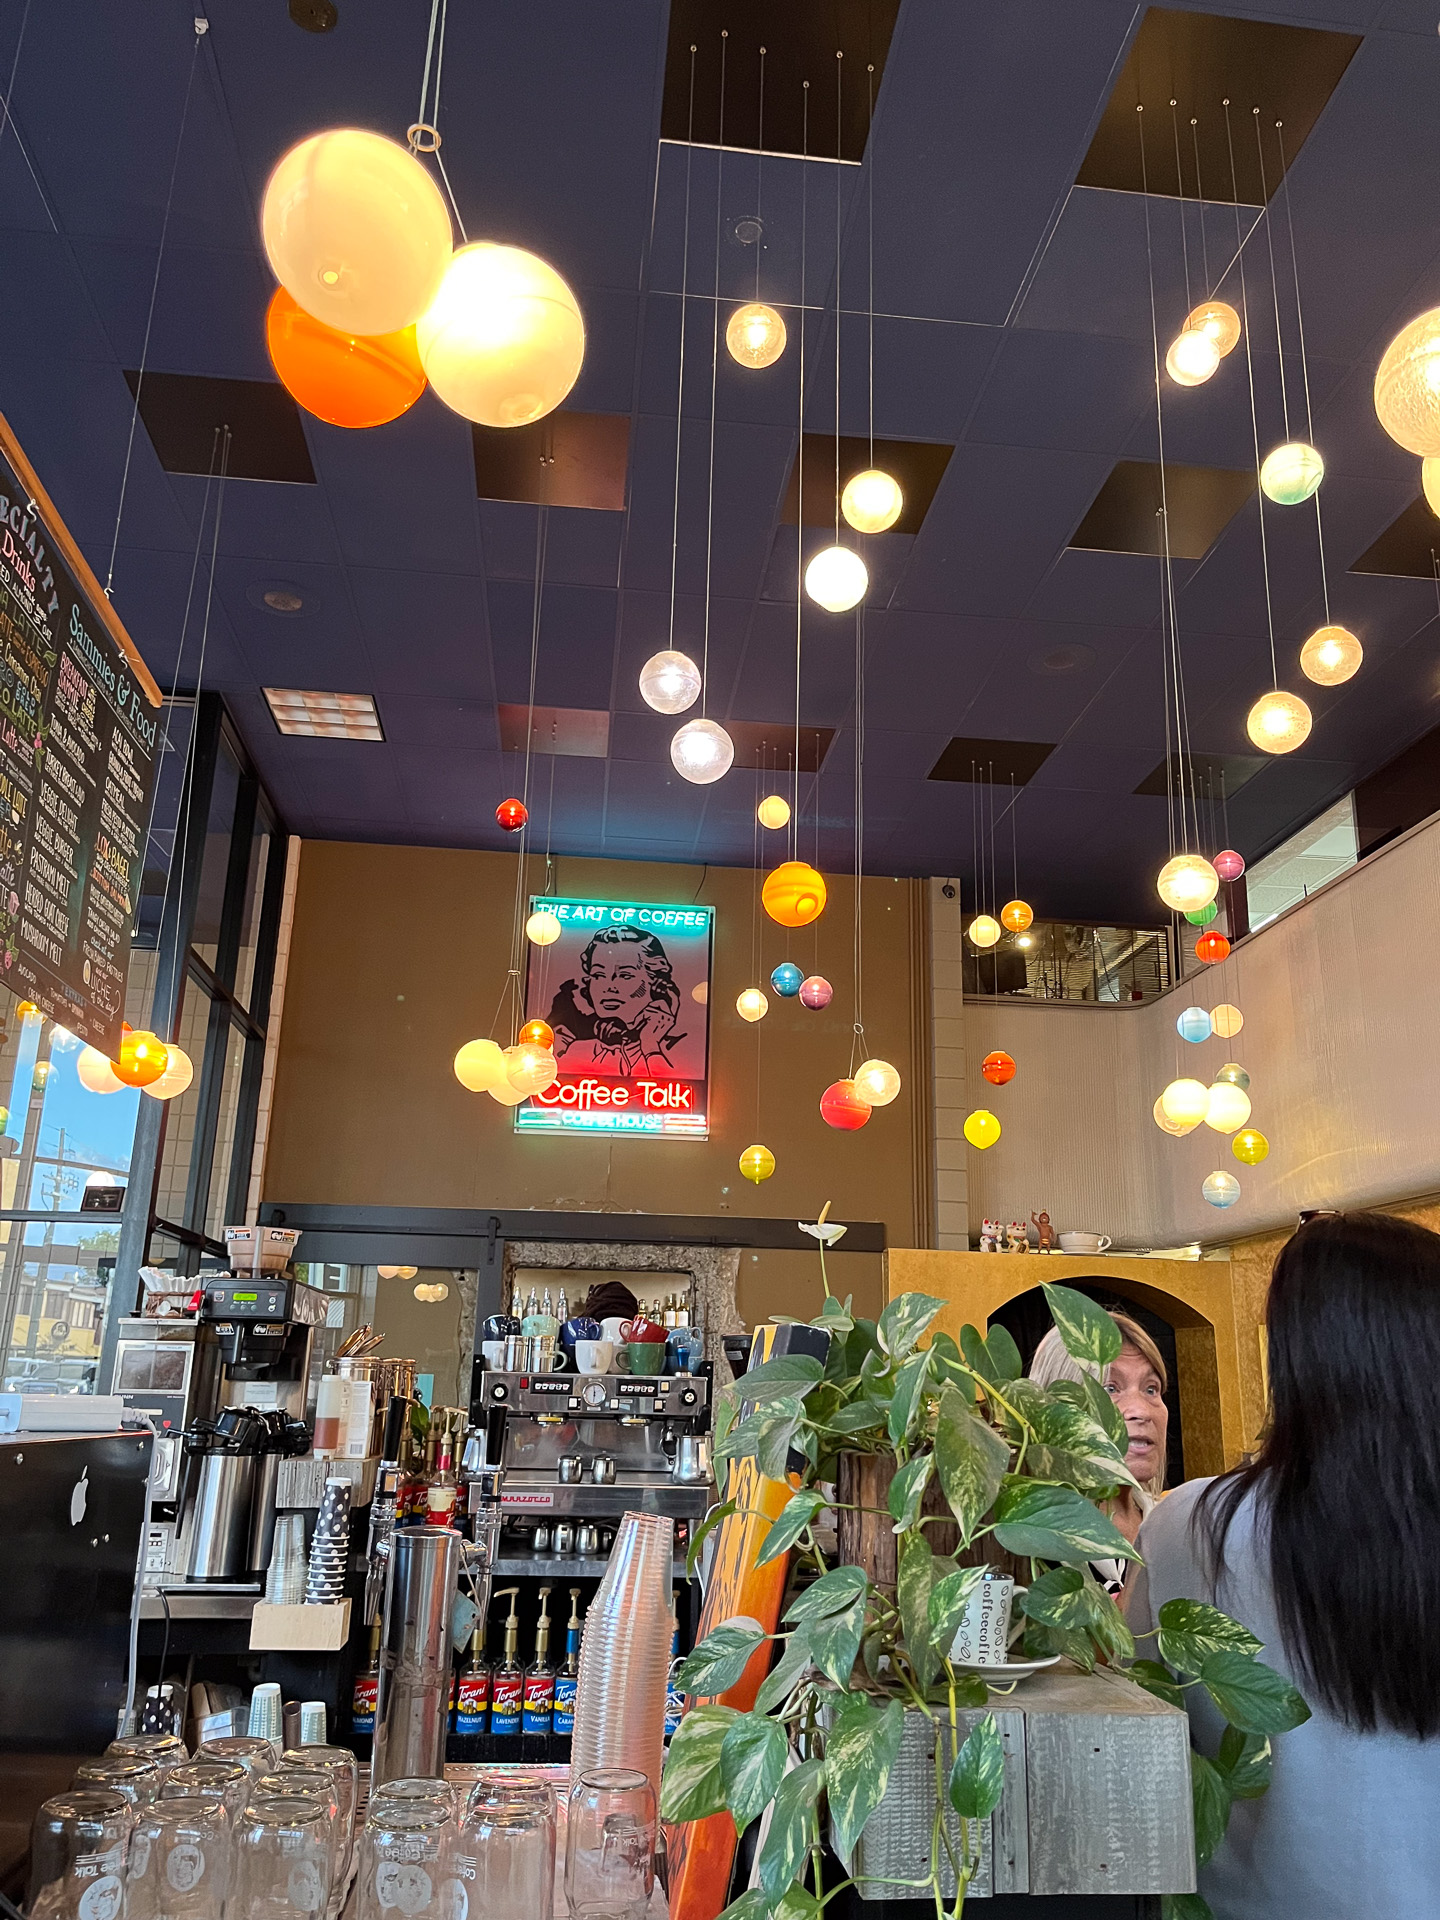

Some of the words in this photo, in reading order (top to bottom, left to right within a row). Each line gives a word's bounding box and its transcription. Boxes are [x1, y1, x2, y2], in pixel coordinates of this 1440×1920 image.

[2, 528, 36, 593] Drinks
[60, 650, 88, 700] BREAKFAST
[69, 602, 117, 692] Sammies
[116, 672, 129, 711] &
[129, 691, 156, 748] Food
[12, 697, 38, 738] LATTE
[39, 778, 58, 811] VEGGIE
[34, 812, 54, 844] VEGGIE
[54, 832, 74, 865] BURGER
[95, 830, 110, 861] LOX
[110, 845, 131, 884] BAGEL
[30, 846, 56, 885] PASTRAMI
[55, 871, 69, 898] MELT
[24, 880, 44, 914] HERBED
[54, 908, 70, 936] CHEESE
[572, 906, 604, 922] ART
[610, 907, 636, 923] OF
[639, 909, 707, 927] COFFEE
[20, 917, 49, 955] MUSHROOM
[48, 941, 62, 966] MELT
[82, 958, 112, 1001] QUICHE
[537, 1078, 629, 1110] Coffee
[636, 1081, 692, 1109] Talk
[562, 1110, 616, 1127] COFFEE
[616, 1112, 664, 1130] HOUSE
[354, 1685, 378, 1700] Toran
[458, 1684, 486, 1703] Torani
[557, 1685, 577, 1702] Tora
[74, 1864, 99, 1879] Talk
